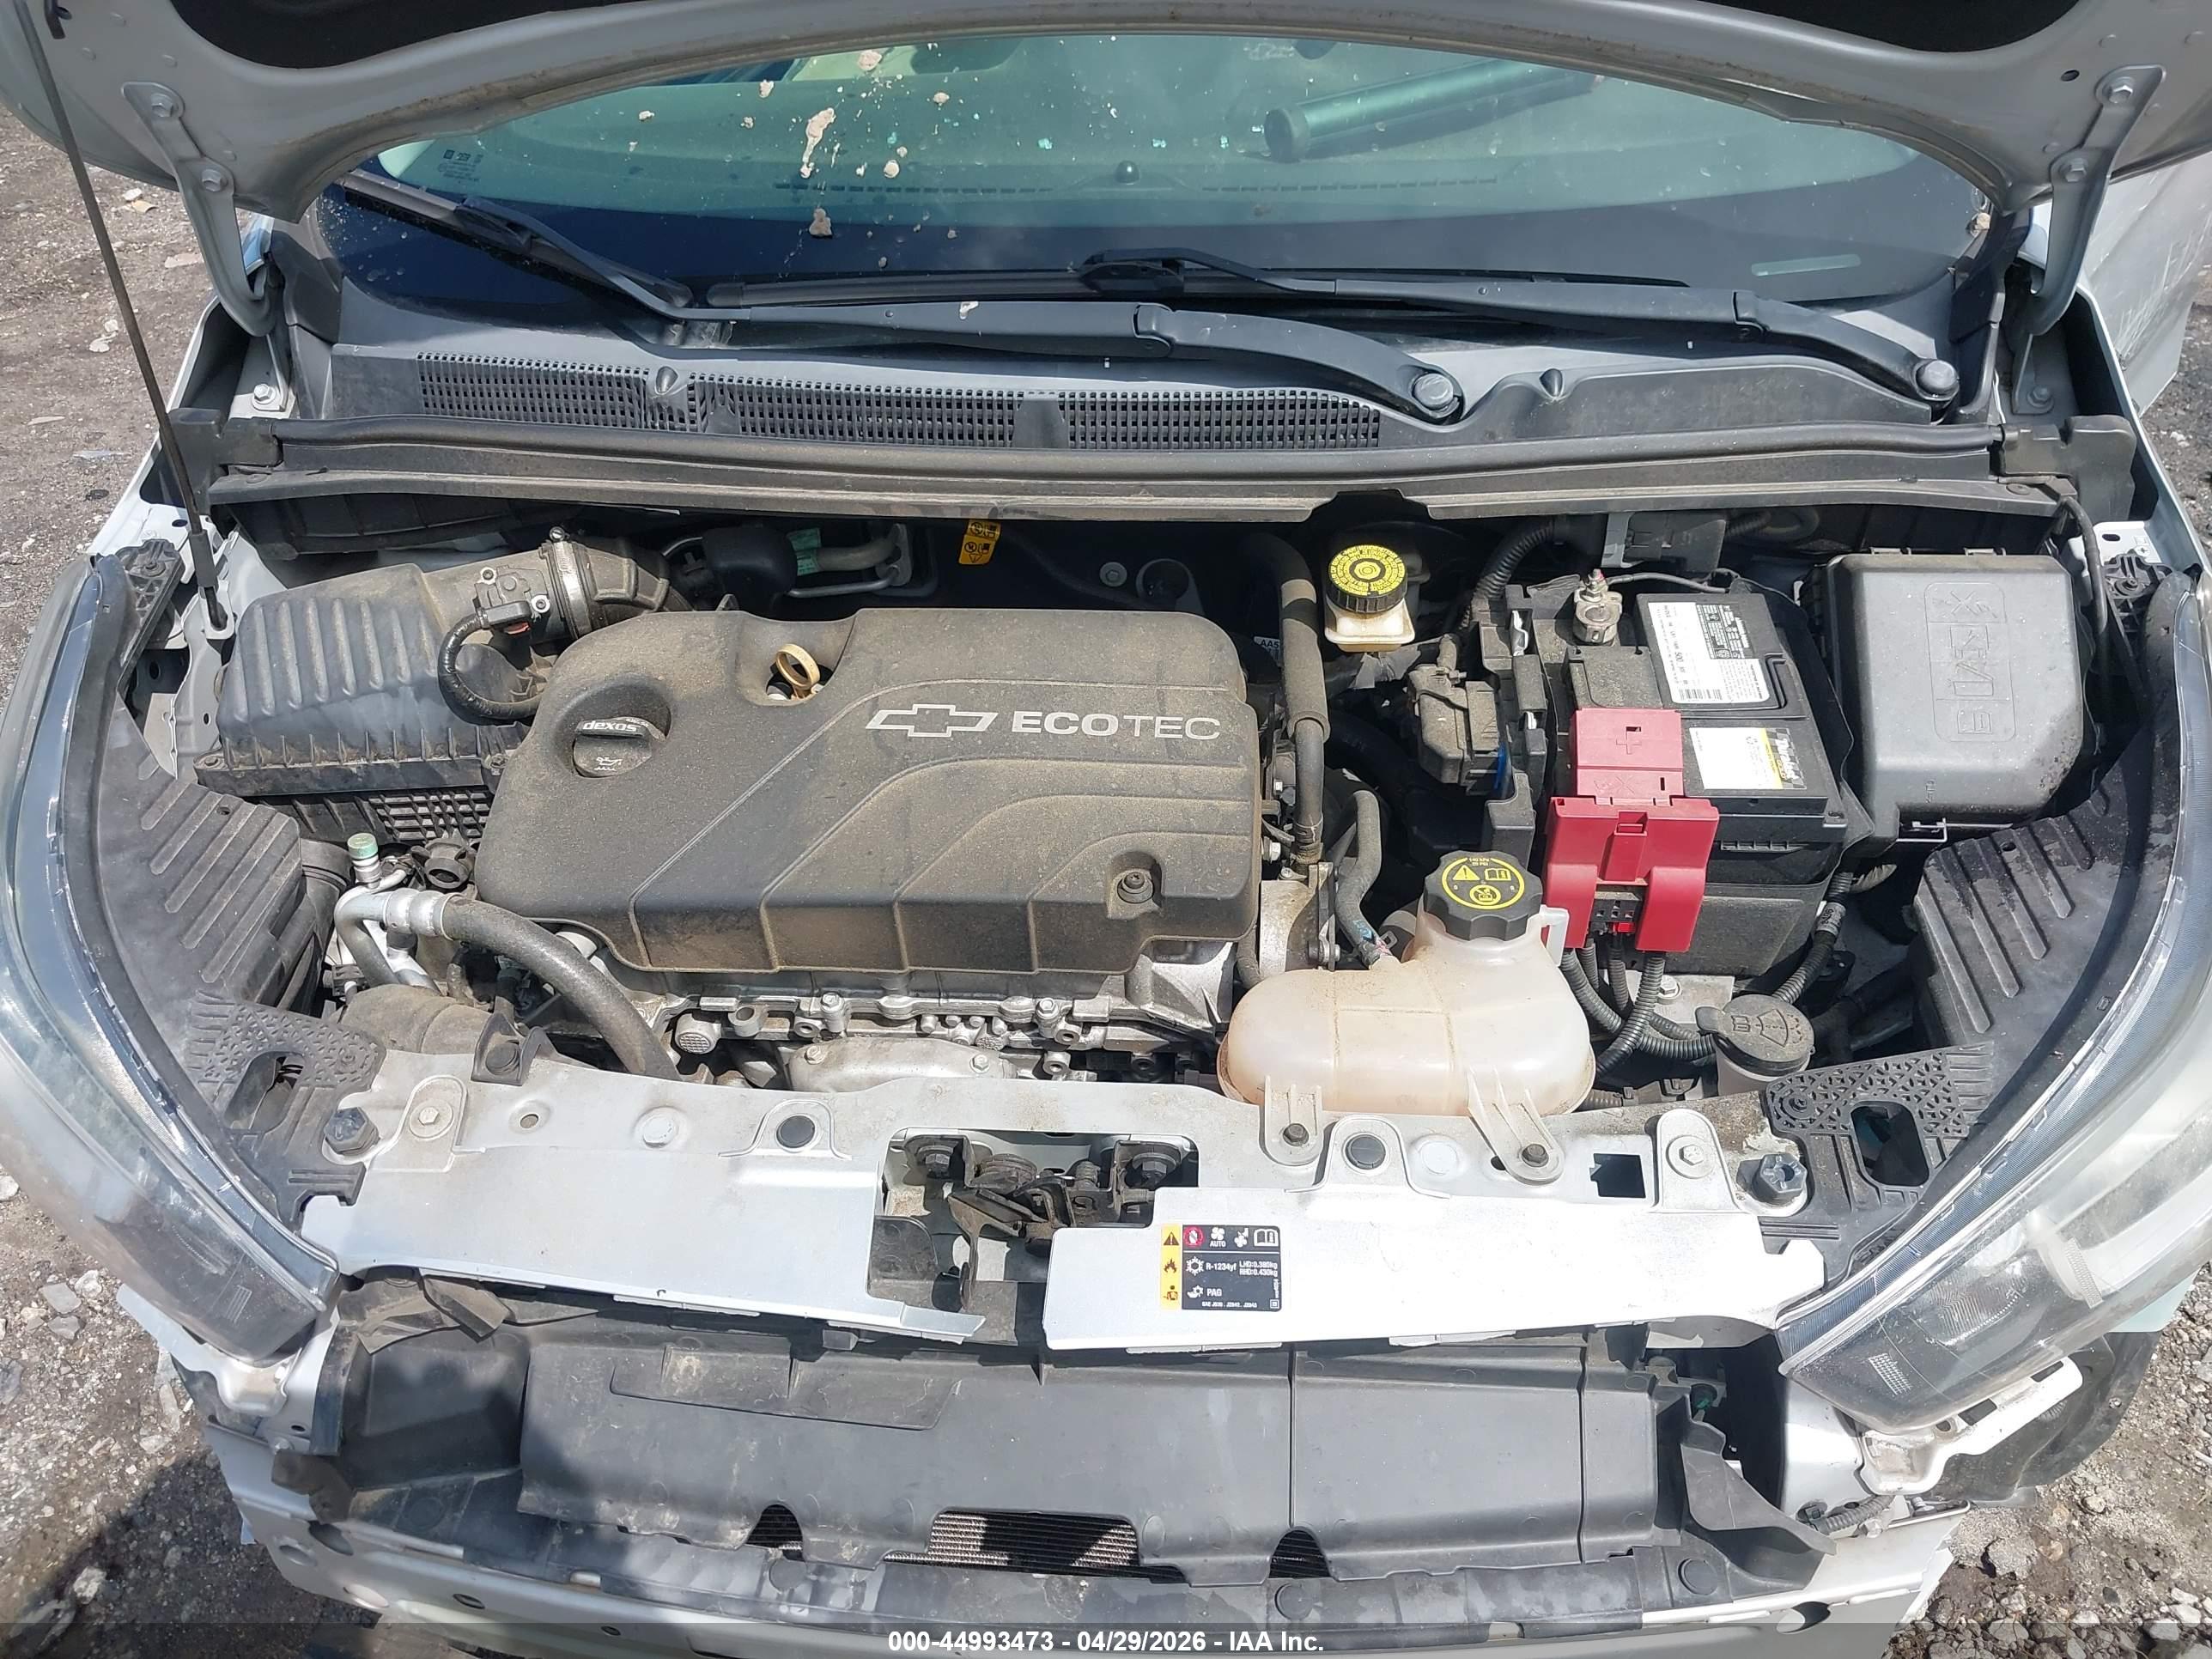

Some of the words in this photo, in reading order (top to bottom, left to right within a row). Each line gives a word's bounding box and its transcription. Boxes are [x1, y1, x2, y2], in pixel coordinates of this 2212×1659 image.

[583, 720, 641, 732] dexos
[1012, 711, 1221, 740] ECOTEC
[1206, 1263, 1237, 1272] R-1234yf
[1206, 1288, 1223, 1297] PAG
